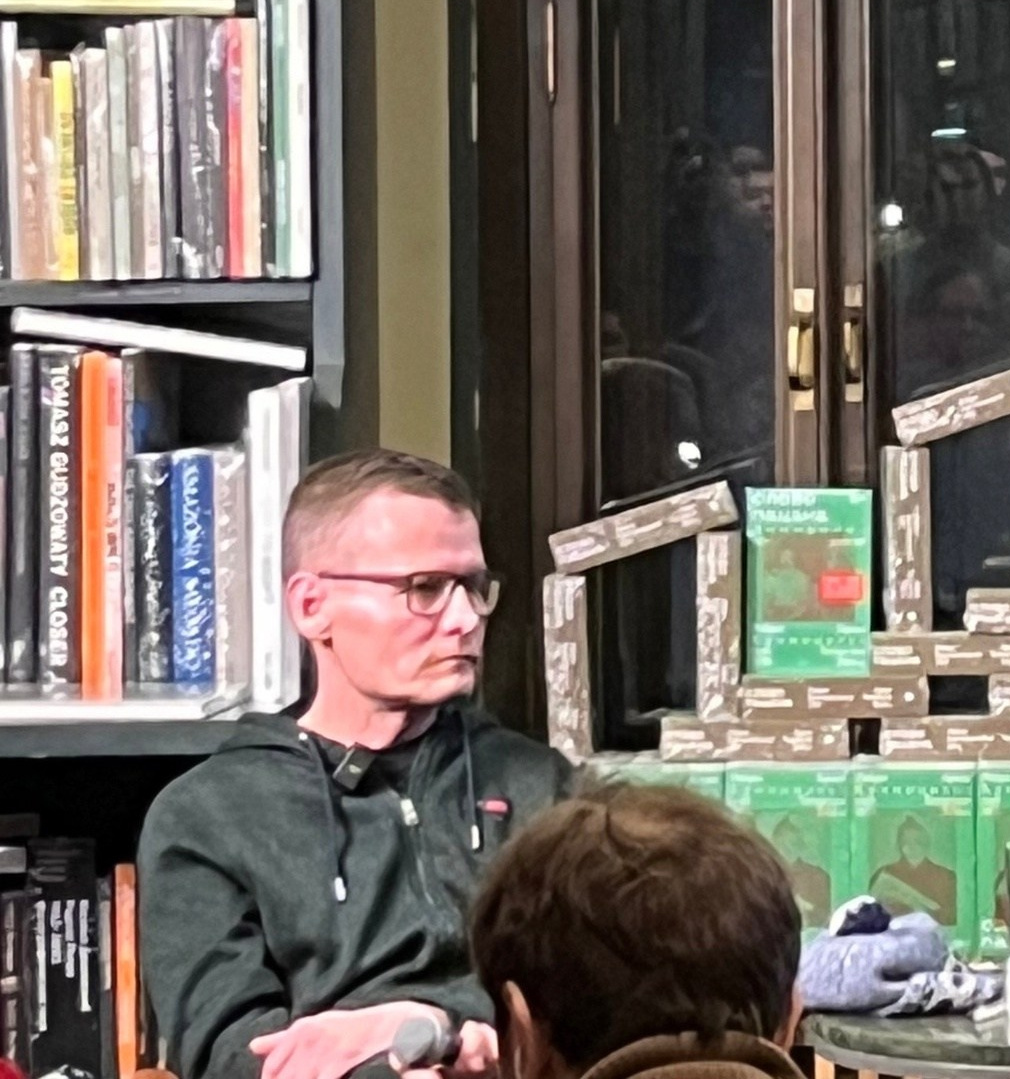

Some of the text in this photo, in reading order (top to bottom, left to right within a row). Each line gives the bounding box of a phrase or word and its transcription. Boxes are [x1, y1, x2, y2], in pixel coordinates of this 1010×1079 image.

[48, 364, 70, 667] TOMASZ GUDZOWATY CLOSER
